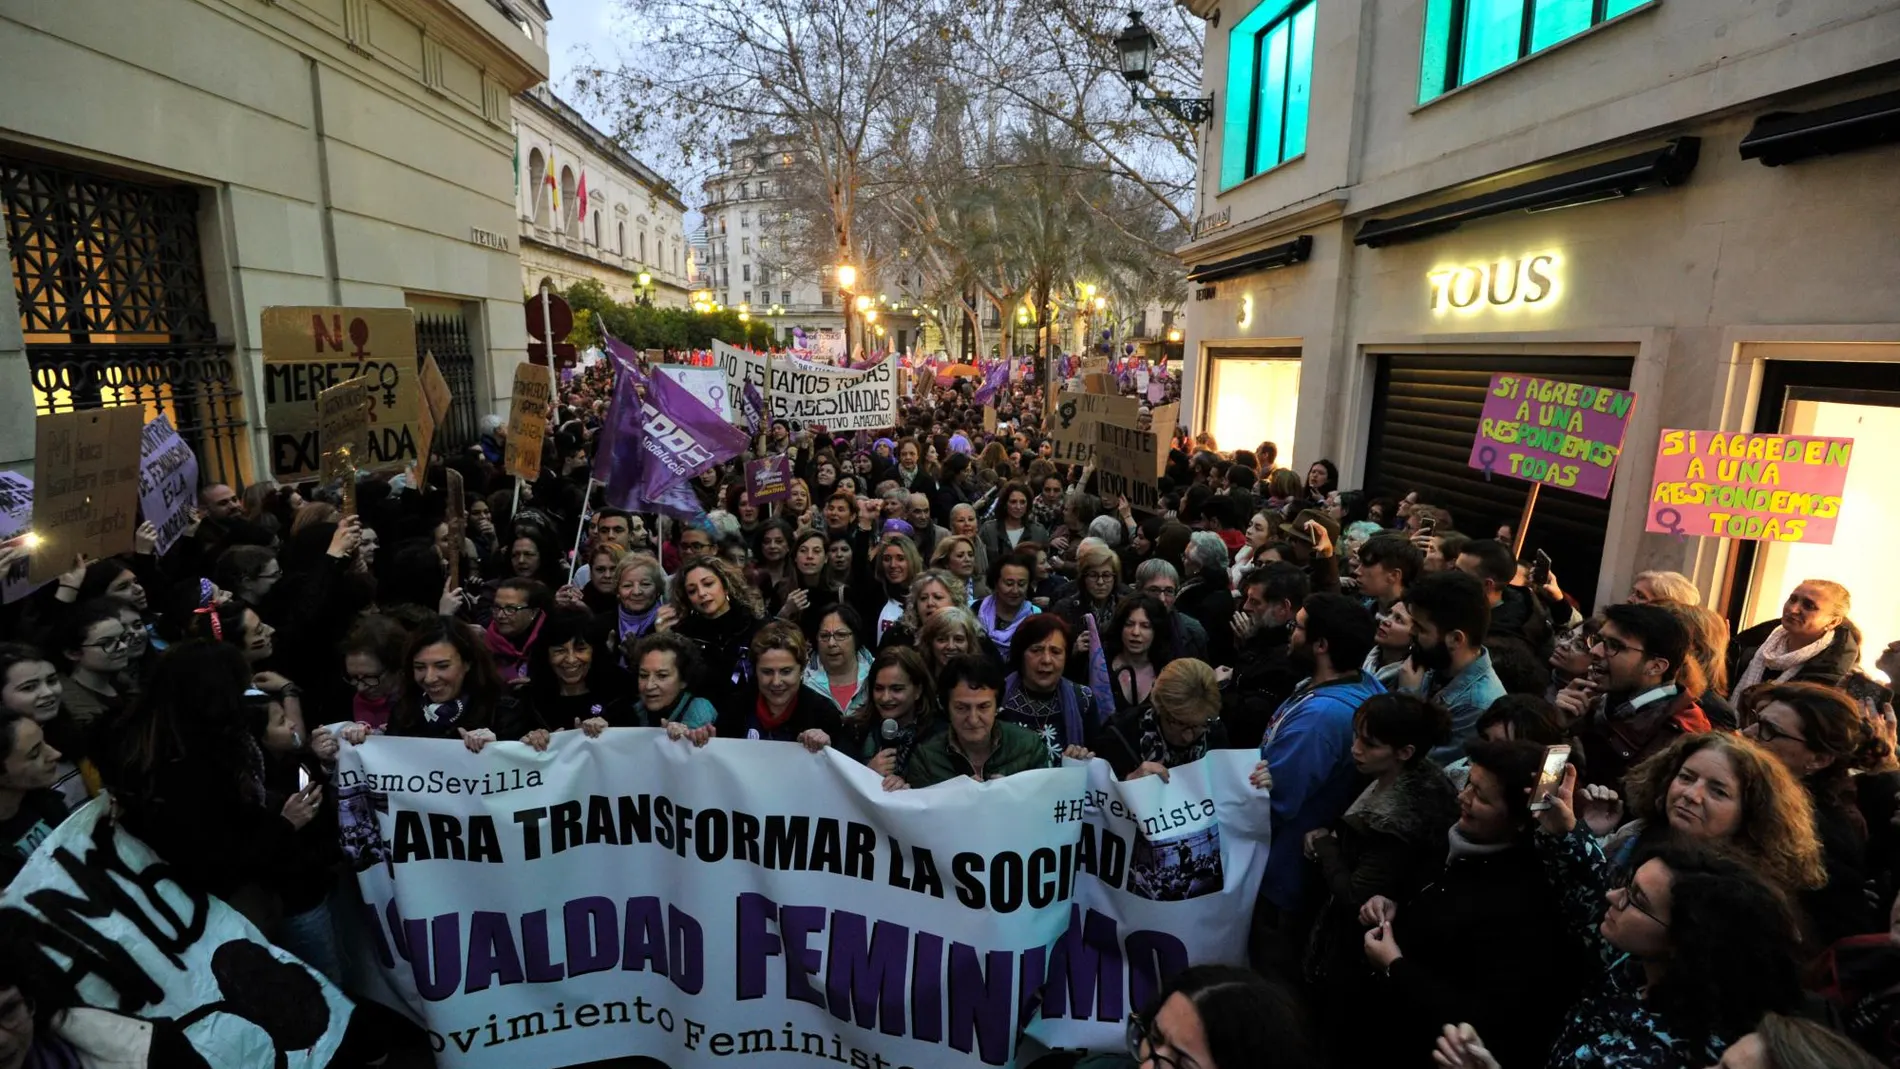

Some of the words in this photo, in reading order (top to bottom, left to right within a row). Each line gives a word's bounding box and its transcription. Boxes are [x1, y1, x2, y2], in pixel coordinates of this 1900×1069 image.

[472, 228, 510, 251] TETUAN
[1428, 254, 1554, 311] TOUS
[265, 361, 400, 409] MEREZCO
[719, 350, 738, 378] NO
[836, 361, 891, 392] TODAS
[795, 388, 890, 418] ASESINADAS
[1525, 378, 1633, 420] AGREDEN
[853, 412, 892, 428] AMAZONAS
[1516, 401, 1530, 422] A
[1538, 404, 1583, 434] UNA
[1481, 417, 1621, 468] RESPONDEMOS
[1707, 433, 1852, 468] AGREDEN
[173, 473, 188, 498] LA
[1508, 453, 1581, 488] TODAS
[1686, 457, 1705, 480] A
[1717, 461, 1780, 486] UNA
[1654, 482, 1843, 520] RESPONDEMOS
[1708, 513, 1808, 542] TODAS
[391, 810, 504, 864] ARA
[513, 793, 876, 882] TRANSFORMAR
[888, 834, 944, 900] LA
[426, 995, 675, 1053] ovimiento
